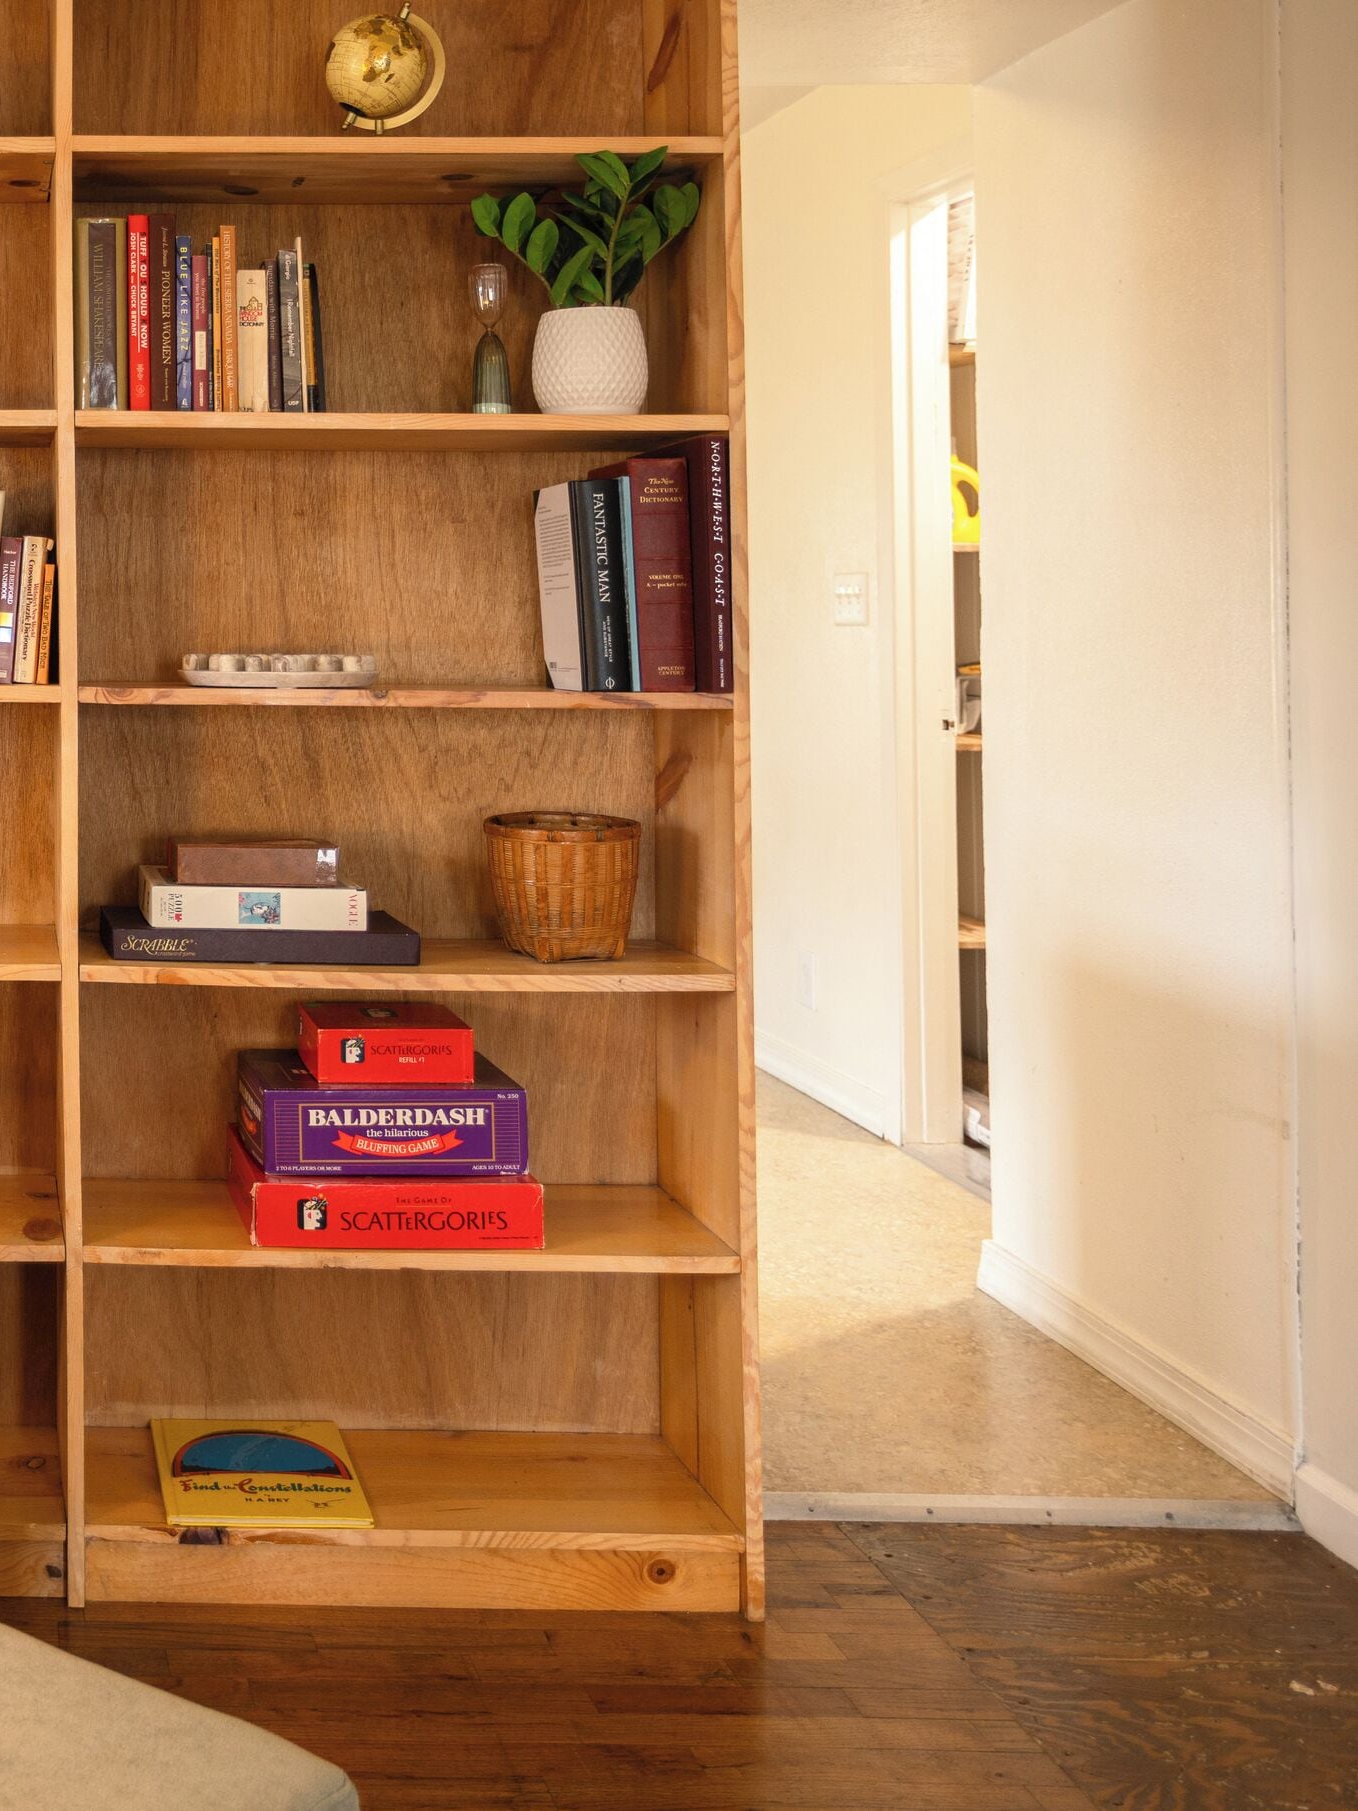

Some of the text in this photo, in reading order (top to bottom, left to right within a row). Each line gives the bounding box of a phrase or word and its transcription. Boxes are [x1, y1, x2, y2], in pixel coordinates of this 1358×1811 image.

[223, 231, 232, 260] HISTORY
[224, 262, 232, 272] OF
[139, 231, 149, 349] STUFF YOU SHOULD KNOW
[224, 273, 232, 289] THE
[92, 243, 104, 369] WILLIAM SHAKESPEARE
[161, 271, 172, 318] PIONEER
[179, 246, 189, 352] BLUE LIKE JAZZ
[198, 298, 206, 314] people
[224, 289, 233, 314] SIERRA
[267, 265, 277, 341] tuesdays with Morrie
[286, 302, 295, 332] Remember
[162, 319, 173, 366] WOMEN
[225, 315, 234, 345] NEVADA
[287, 333, 297, 358] Nightfall
[225, 348, 234, 389] FARQUHAR
[643, 486, 679, 494] CENTURY
[648, 477, 660, 485] The
[639, 496, 683, 504] DICTIONARY
[592, 492, 611, 603] FANTASTIC MAN
[0, 562, 9, 601] HANDBOOK
[6, 559, 16, 605] THE BEDFORD
[25, 558, 36, 597] Crossword
[657, 580, 675, 589] pocket
[31, 583, 39, 607] Webster's
[23, 597, 33, 622] Puzzle
[39, 579, 52, 670] THE TALE TWO BAD MICE
[20, 622, 31, 661] Dictionary
[167, 893, 175, 922] PUZZLE
[175, 894, 184, 913] 500
[348, 894, 358, 926] VOGUE
[120, 935, 187, 956] SCRABBLE
[370, 1045, 452, 1056] SCATTERGORIES
[398, 1056, 417, 1064] REFILL
[307, 1108, 485, 1127] BALDERDASH
[366, 1128, 429, 1138] the hilarious
[355, 1138, 440, 1154] BLUFFING GAME
[340, 1211, 508, 1231] SCATTERGORIES
[179, 1478, 352, 1495] Find Constellations
